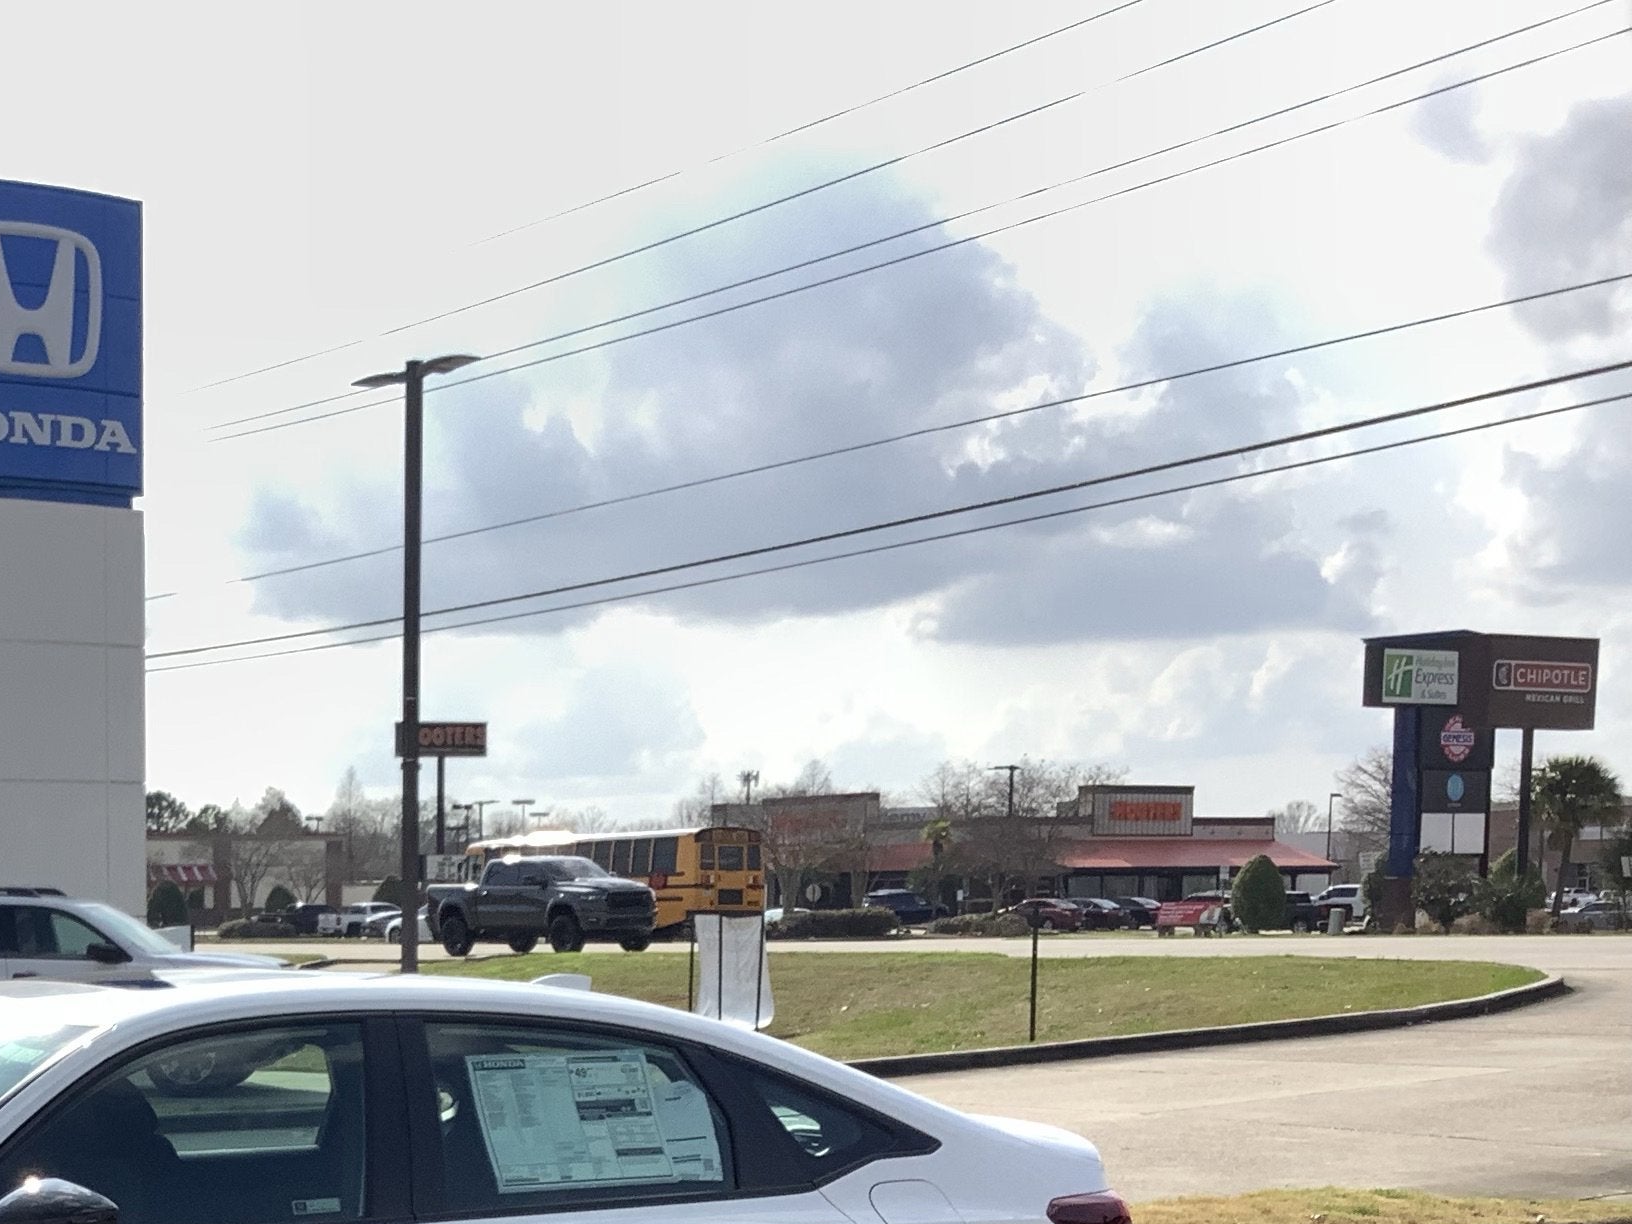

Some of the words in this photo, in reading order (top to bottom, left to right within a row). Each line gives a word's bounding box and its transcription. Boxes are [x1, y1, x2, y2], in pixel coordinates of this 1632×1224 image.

[1414, 667, 1456, 687] Express
[1516, 667, 1588, 686] CHIPOTLE
[1525, 693, 1561, 703] MEXICAN
[418, 727, 486, 747] OOTERS
